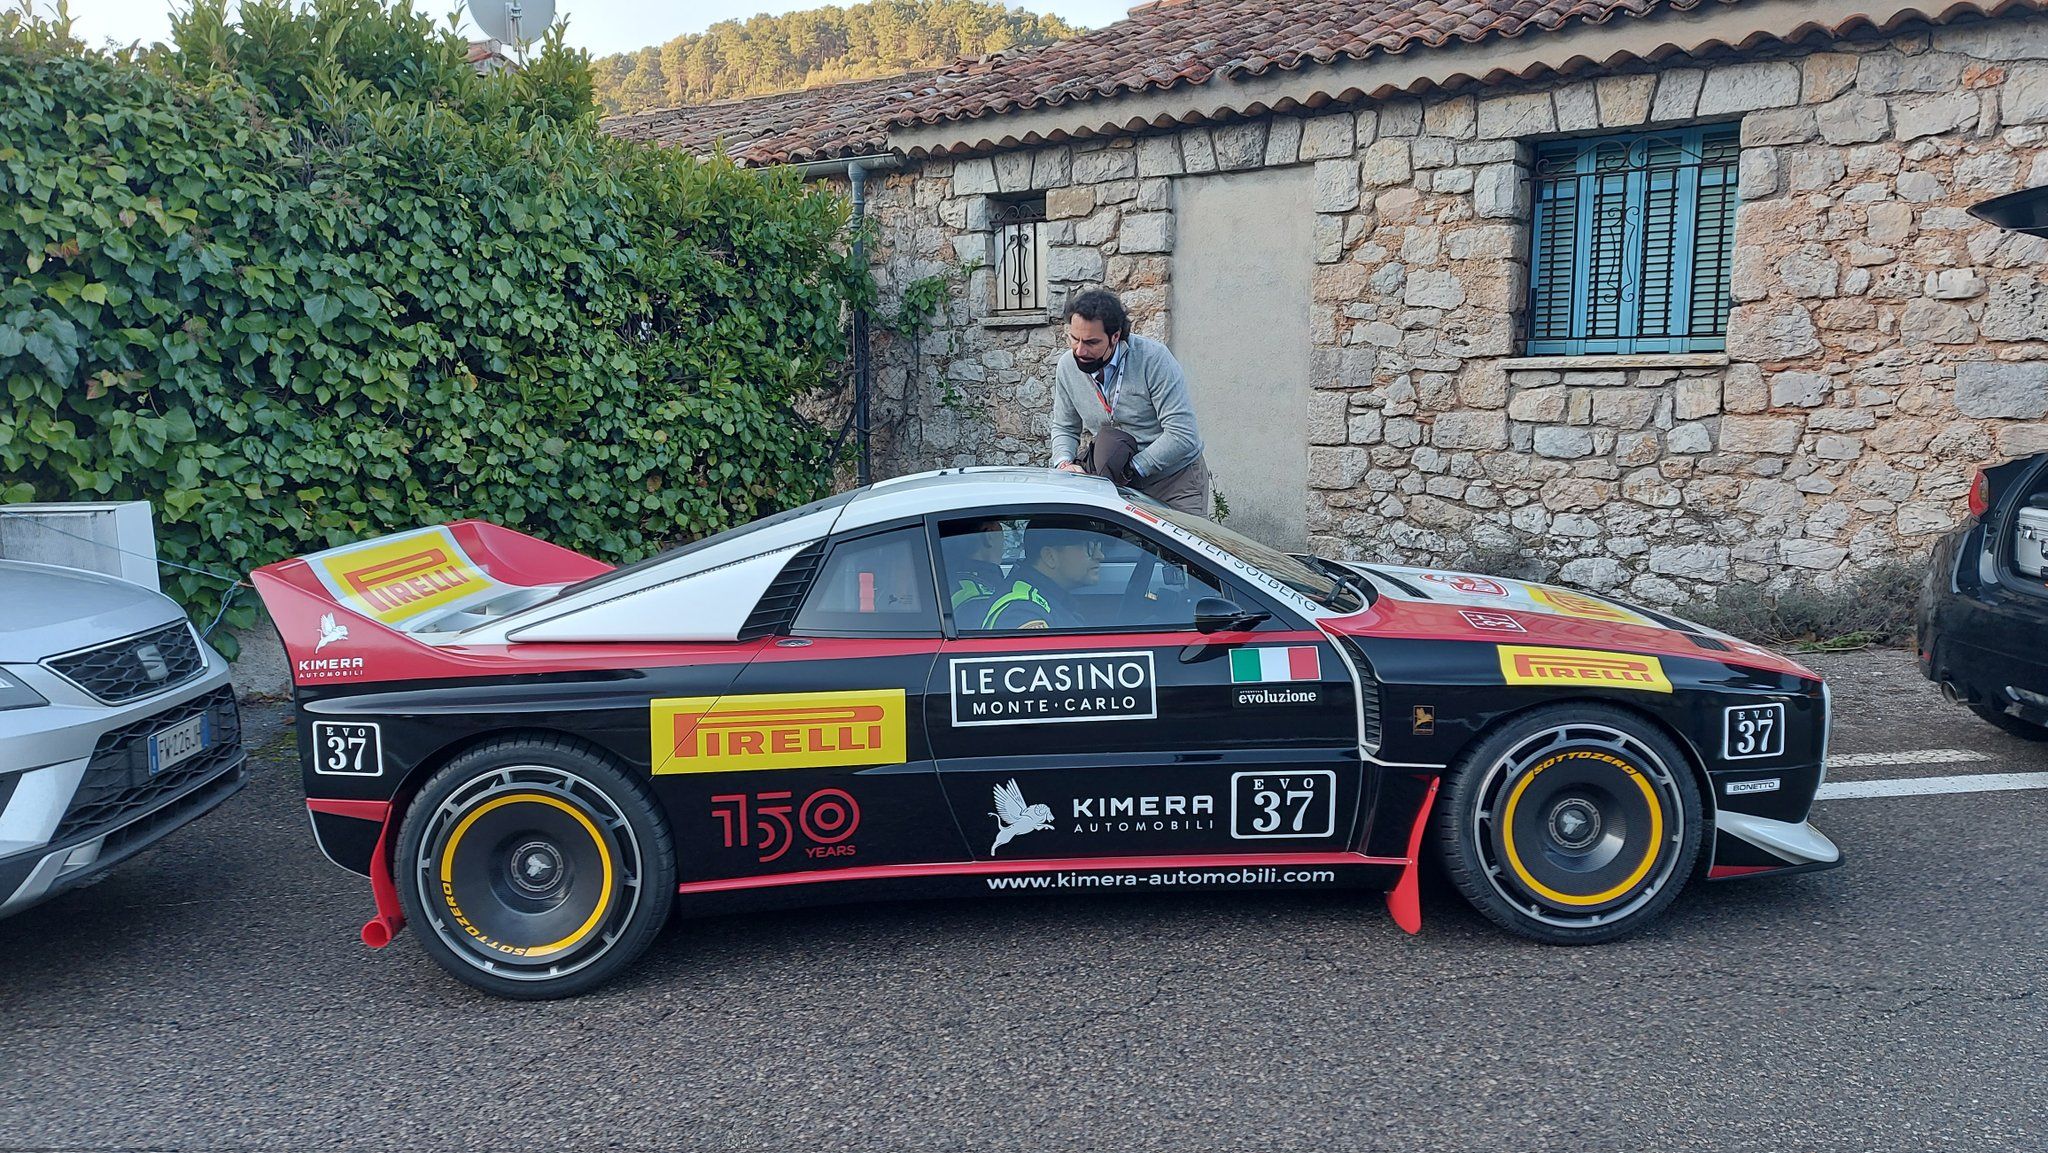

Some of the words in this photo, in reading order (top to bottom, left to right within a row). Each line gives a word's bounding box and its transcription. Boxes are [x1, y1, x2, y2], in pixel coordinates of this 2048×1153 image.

[343, 548, 470, 612] PIRELLI
[1234, 561, 1317, 612] SOLBERG
[299, 657, 363, 671] KIMERA
[299, 670, 363, 679] AUTOMOBILI
[1513, 654, 1654, 682] PIRELLI
[961, 668, 995, 695] LE
[1004, 662, 1145, 693] CASINO
[973, 699, 1048, 715] MONTE
[1064, 696, 1136, 711] CARLO
[1238, 689, 1316, 704] evoluzione
[1738, 709, 1773, 720] EVO
[326, 727, 366, 737] EVO
[673, 705, 885, 758] PIRELLI
[1737, 719, 1773, 754] 37
[327, 736, 366, 770] 37
[1534, 751, 1638, 775] SOTTOZERO
[1253, 777, 1315, 790] EVO
[1733, 781, 1775, 791] BONETTO
[1073, 795, 1213, 818] KIMERA
[1252, 791, 1315, 832] 37
[710, 788, 861, 863] 150
[1074, 820, 1213, 833] AUTOMOBILI
[805, 845, 857, 858] YEARS
[986, 868, 1335, 889] www.kimera-automobili.com
[442, 882, 526, 956] SOTTOZERO
